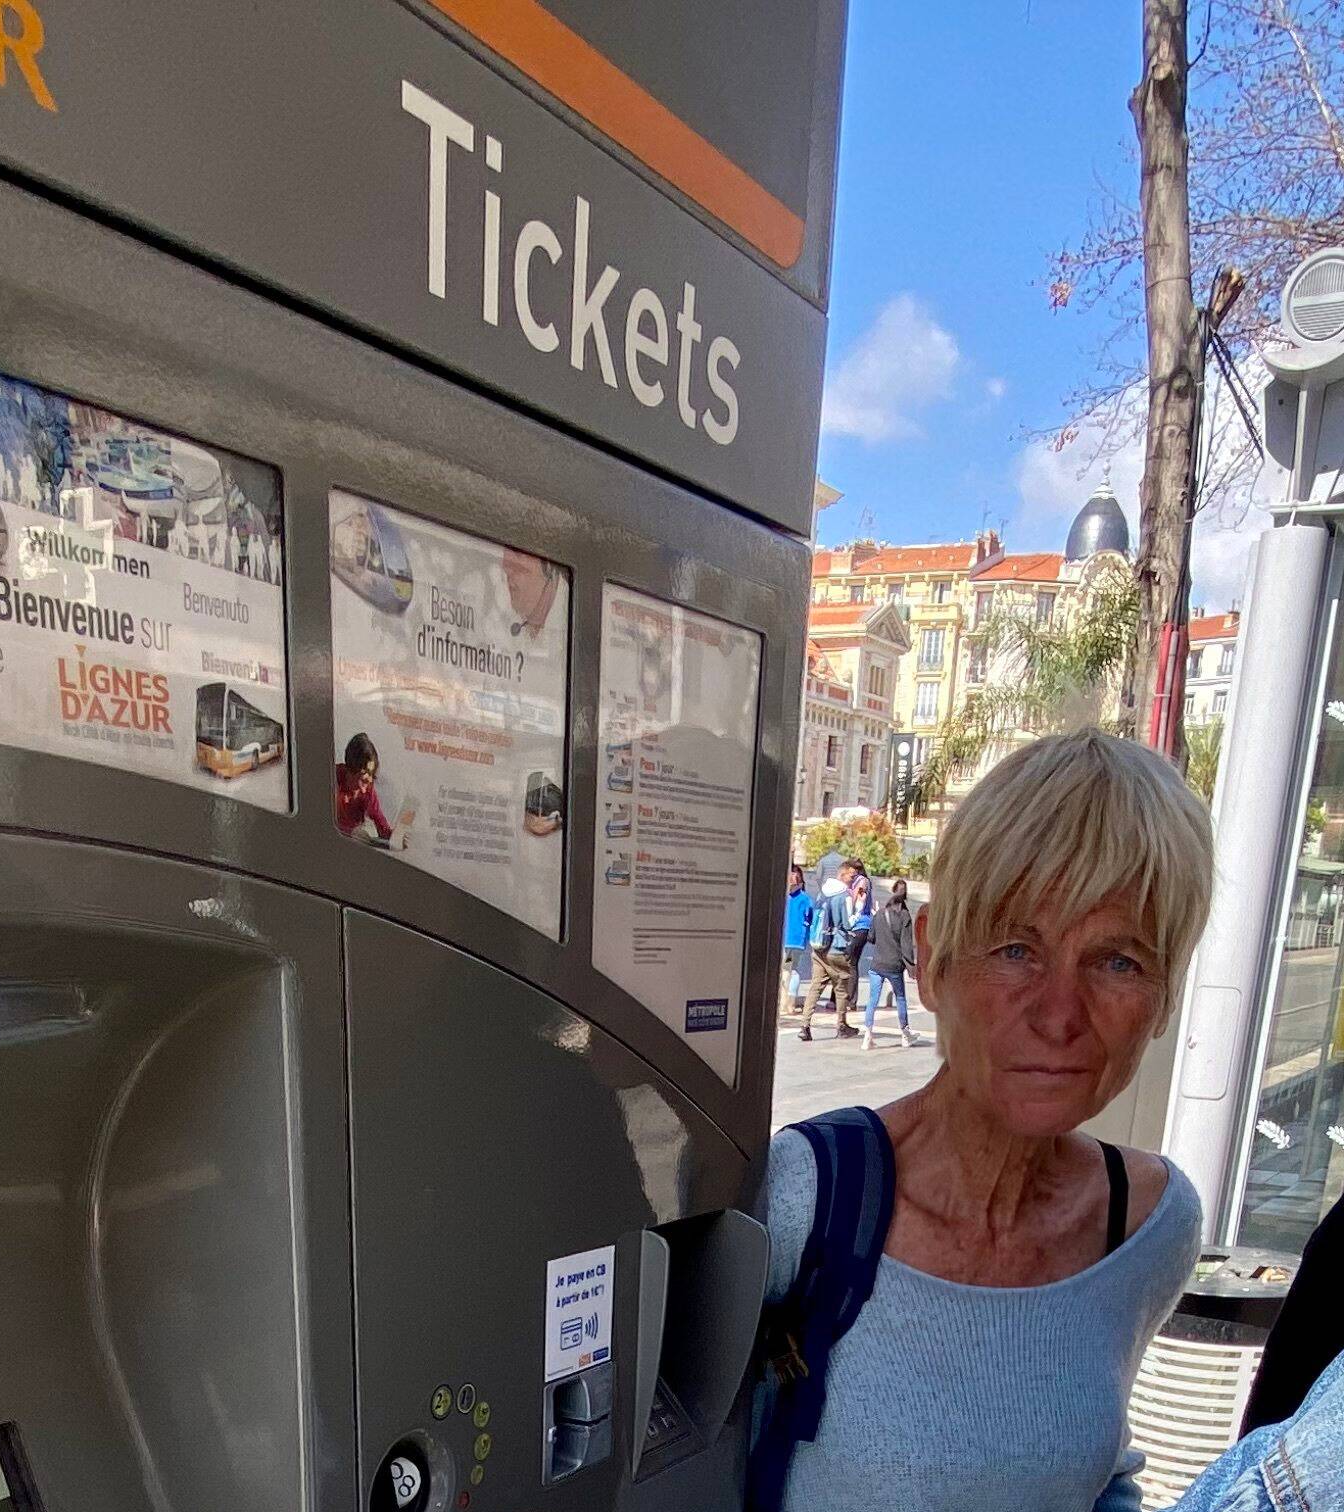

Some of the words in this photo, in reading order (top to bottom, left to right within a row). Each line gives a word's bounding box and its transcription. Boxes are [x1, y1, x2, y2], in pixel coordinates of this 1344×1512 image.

[401, 79, 742, 446] Tickets
[183, 582, 249, 625] Benvenuto
[430, 583, 475, 631] Besoin
[141, 617, 172, 652] sur
[417, 625, 513, 678] d'information
[514, 653, 525, 683] ?
[60, 691, 173, 735] D'AZUR
[567, 1272, 585, 1286] paye
